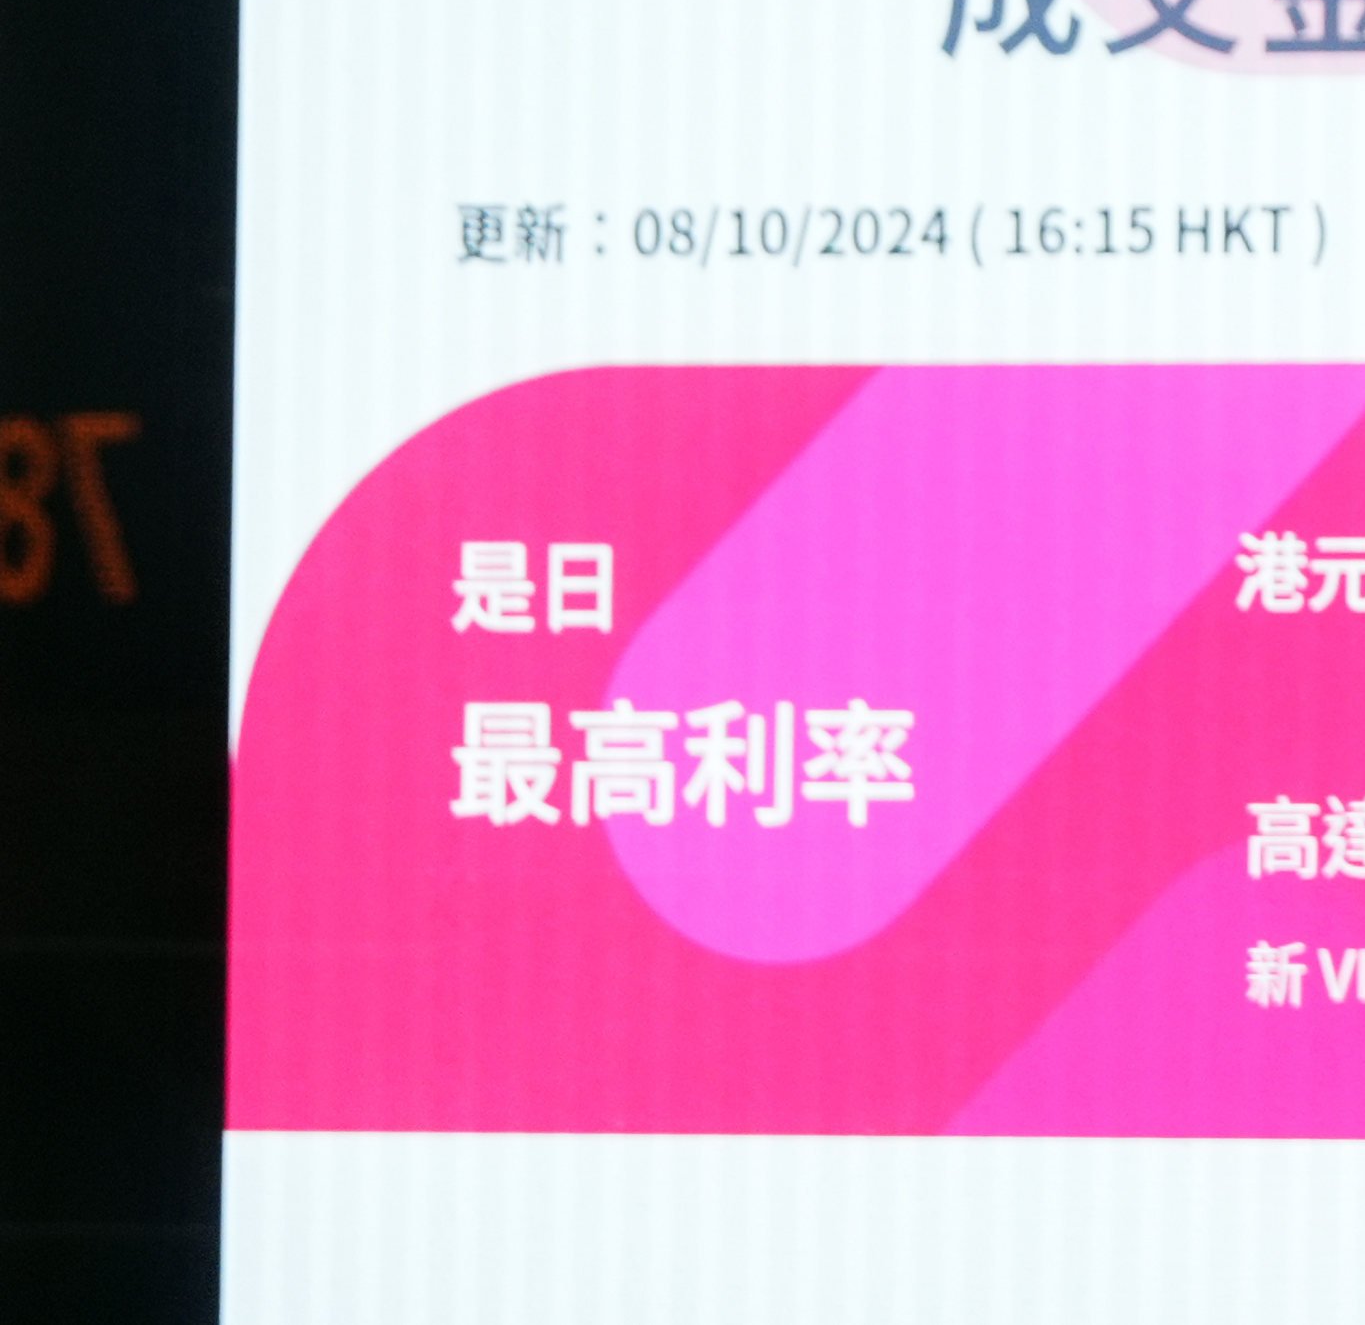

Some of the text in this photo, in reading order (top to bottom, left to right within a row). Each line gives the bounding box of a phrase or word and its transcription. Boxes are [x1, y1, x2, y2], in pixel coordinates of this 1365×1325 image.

[451, 540, 614, 633] 是日
[449, 697, 916, 828] 最高利率
[1245, 939, 1308, 1007] 新
